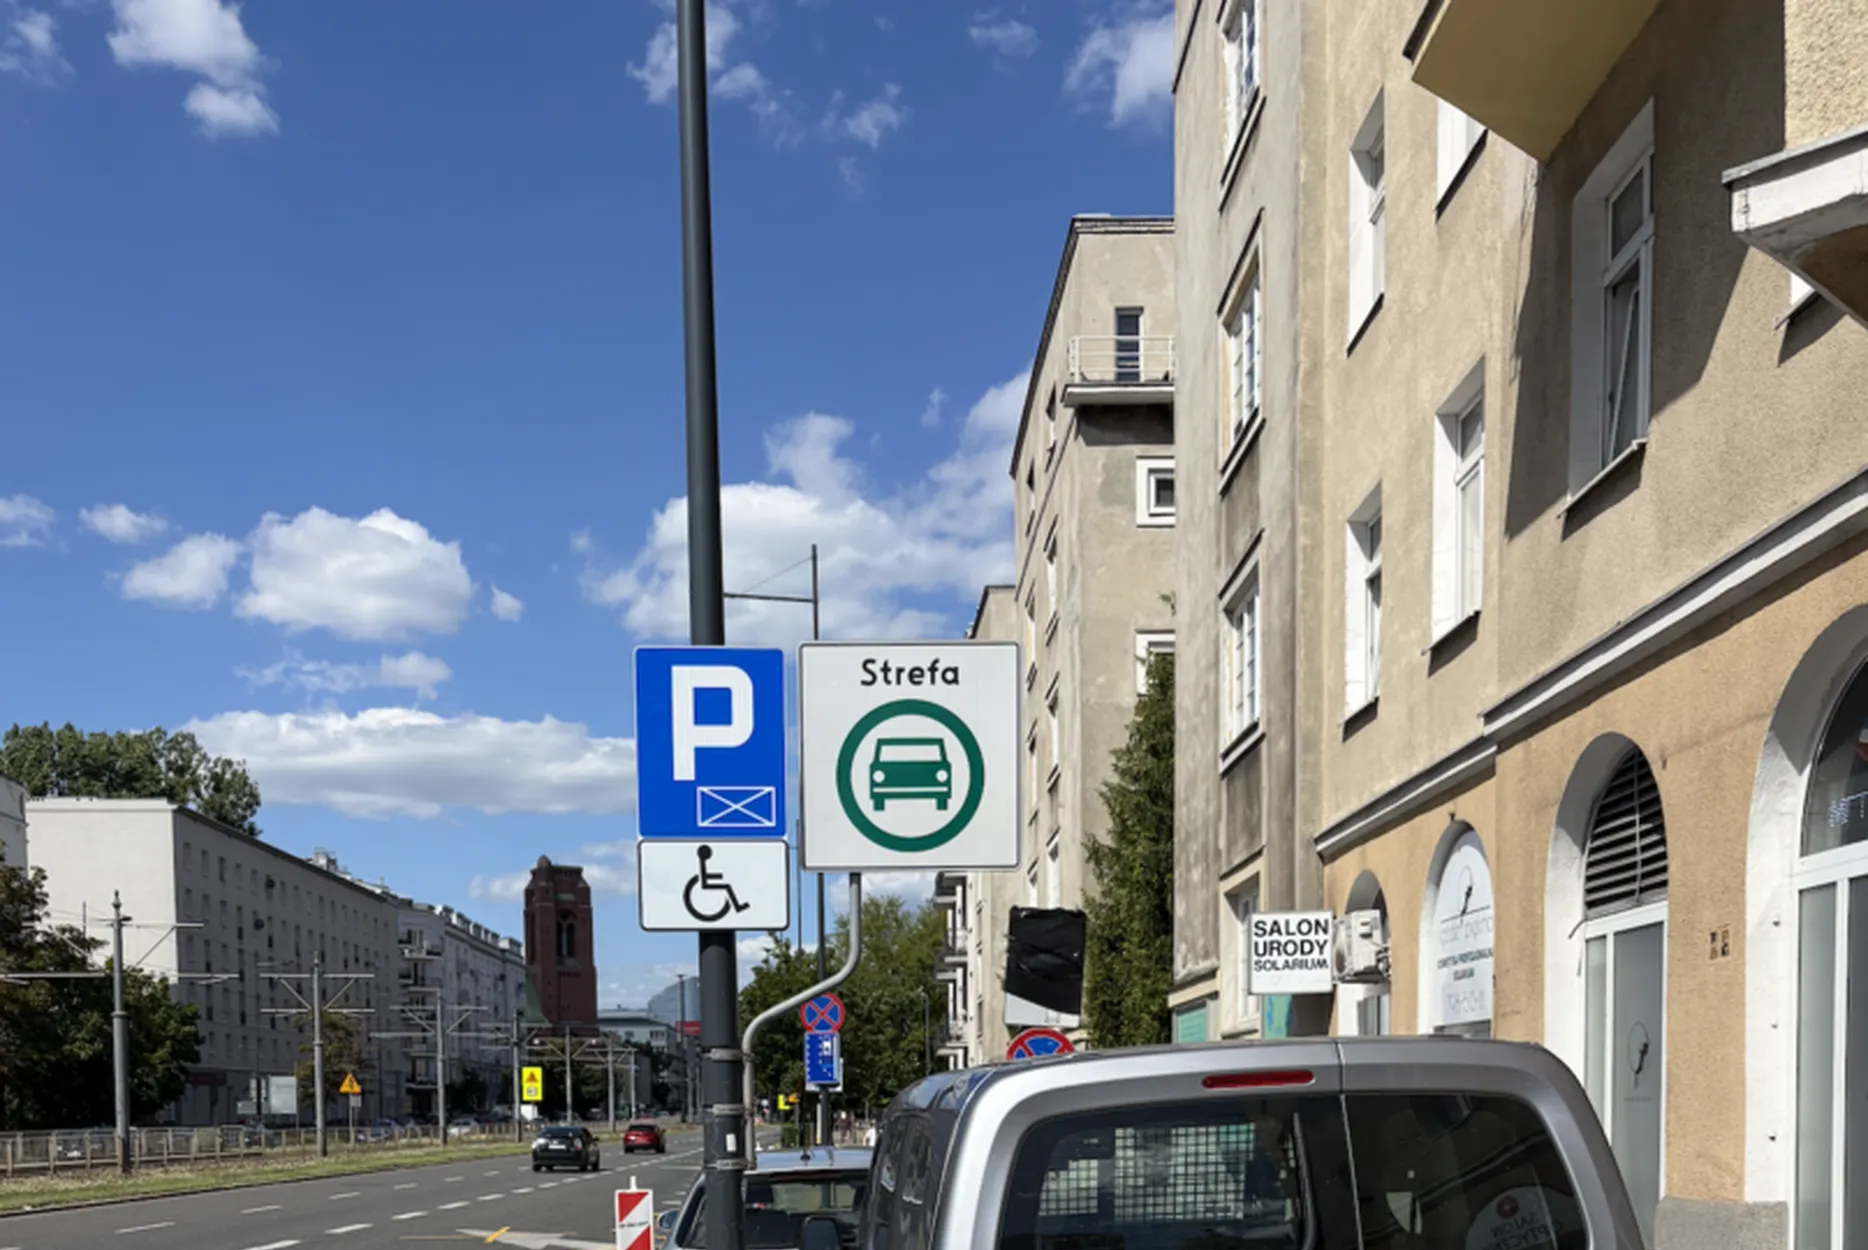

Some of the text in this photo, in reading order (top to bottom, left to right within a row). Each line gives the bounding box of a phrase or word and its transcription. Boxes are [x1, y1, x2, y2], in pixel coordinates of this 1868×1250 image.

[860, 658, 961, 687] Strefa
[671, 665, 755, 781] P
[1253, 918, 1329, 938] SALON
[1253, 939, 1328, 957] URODY
[1253, 958, 1329, 972] SOLARIUM
